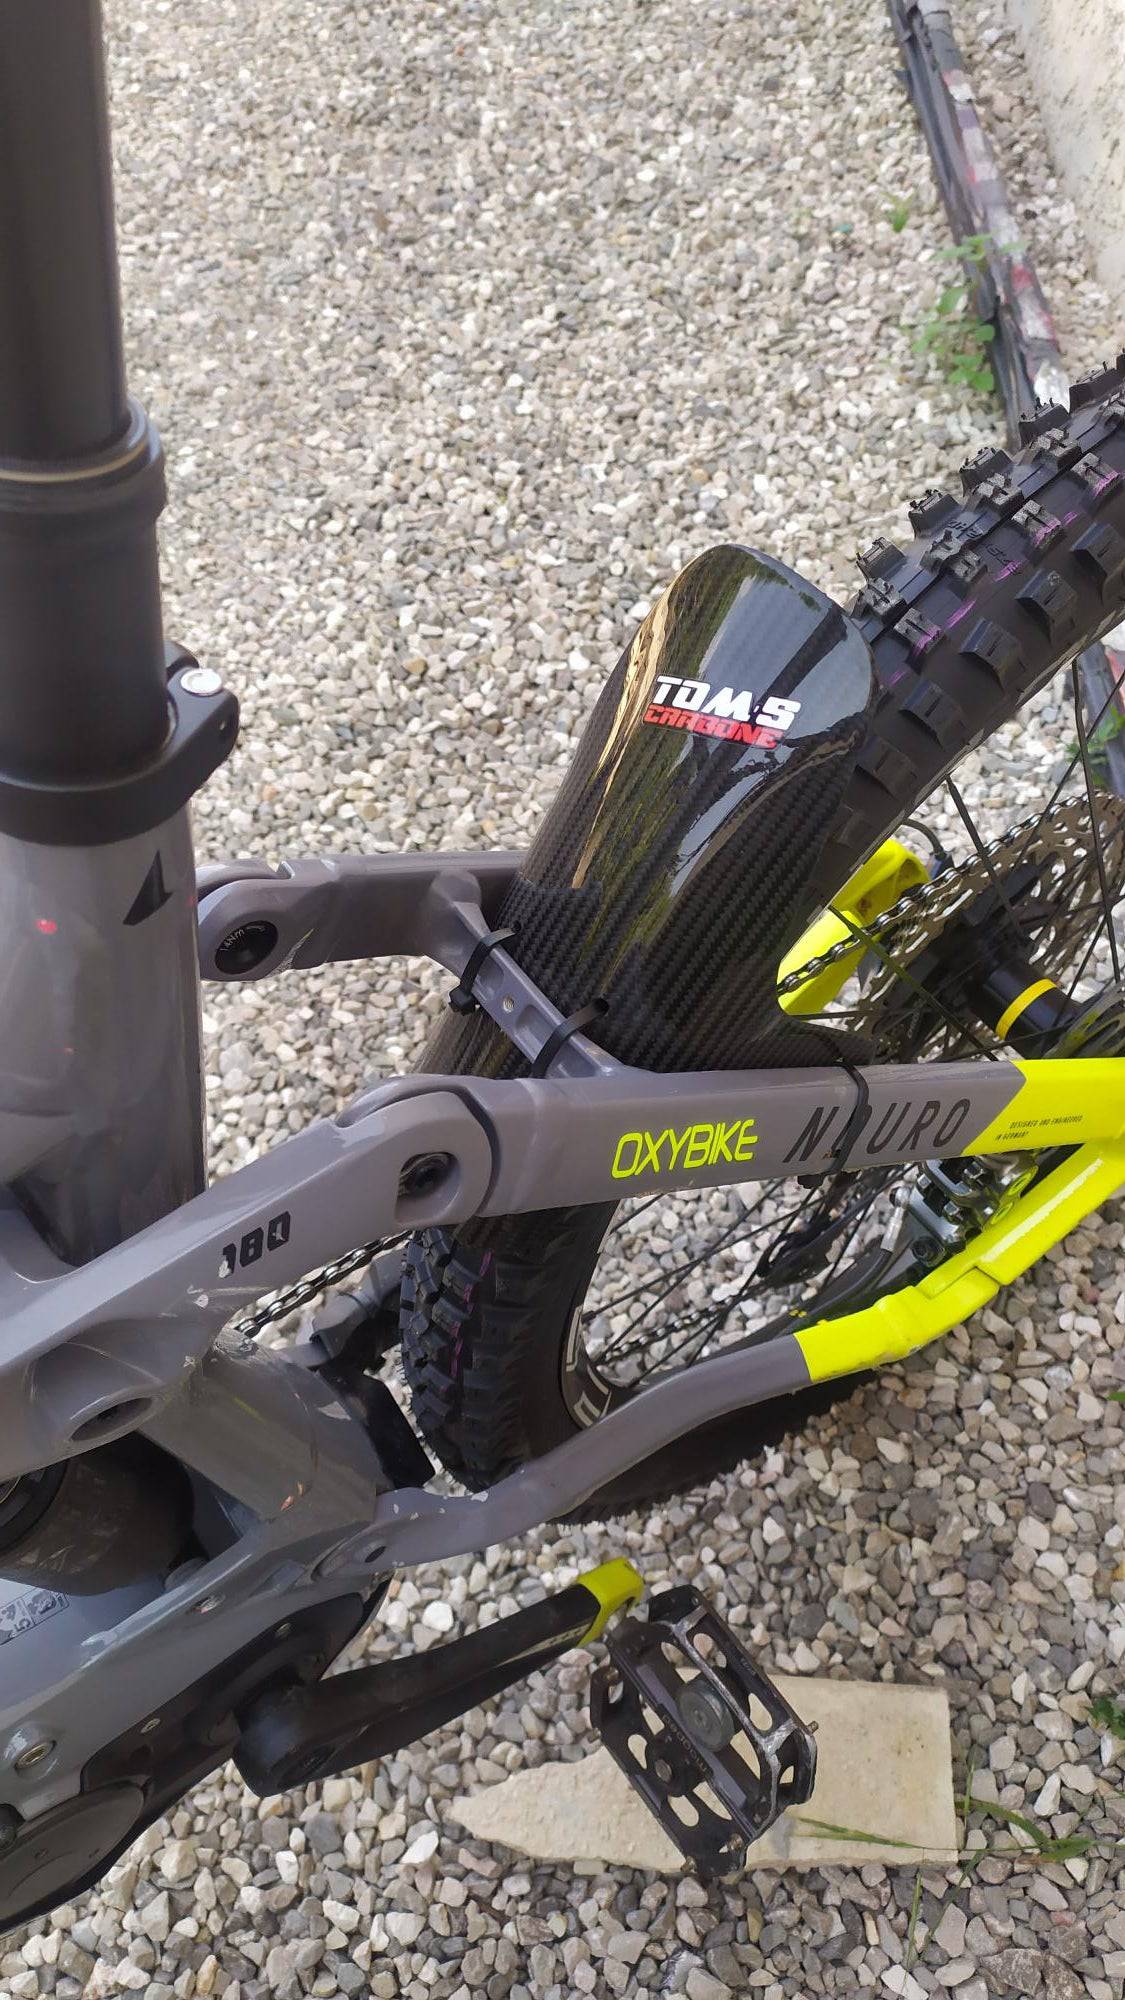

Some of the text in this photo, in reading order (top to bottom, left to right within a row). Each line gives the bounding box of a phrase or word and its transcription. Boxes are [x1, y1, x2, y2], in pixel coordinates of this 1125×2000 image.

[643, 704, 784, 750] CARBONE
[612, 1119, 758, 1179] OXYBIKE
[218, 1211, 291, 1278] 180
